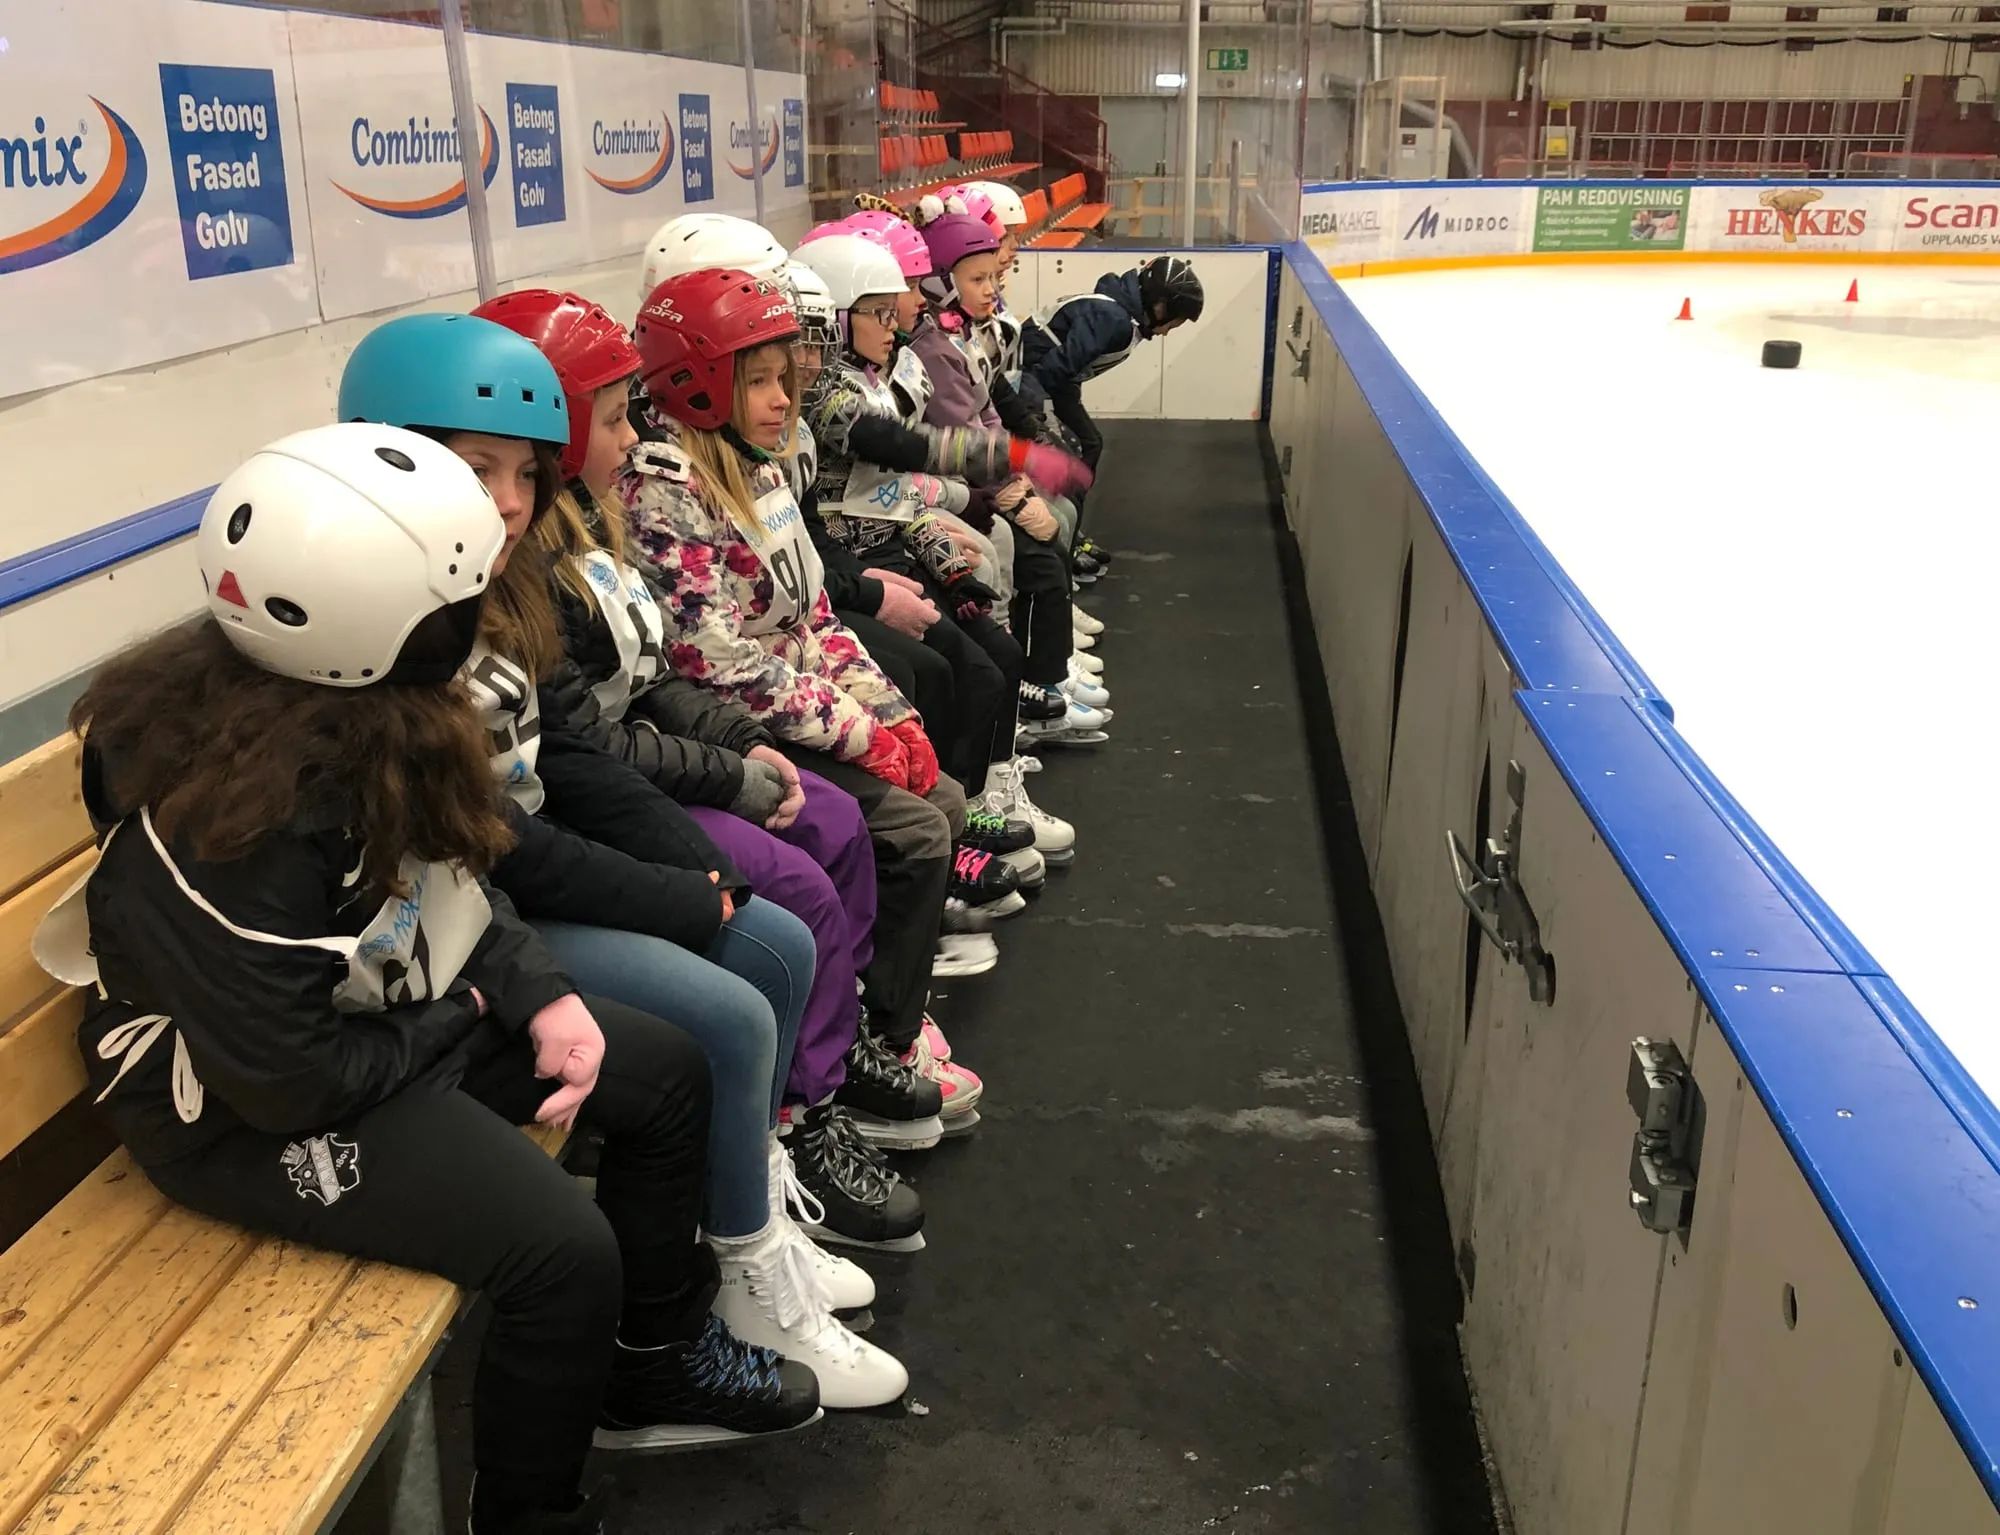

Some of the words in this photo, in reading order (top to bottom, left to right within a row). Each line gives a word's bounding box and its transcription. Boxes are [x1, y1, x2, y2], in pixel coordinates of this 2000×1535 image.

[179, 94, 268, 140] Betong
[514, 103, 555, 135] Betong
[683, 108, 708, 132] Betong
[352, 116, 461, 166] Combimi
[593, 119, 661, 155] Combimix
[685, 139, 705, 158] Fasad
[517, 143, 551, 168] Fasad
[187, 152, 260, 192] Fasad
[687, 168, 702, 188] Golv
[520, 182, 545, 207] Golv
[1543, 189, 1573, 206] PAM
[1578, 189, 1684, 206] REDOVISNING
[1444, 216, 1509, 233] MIDROC
[1725, 208, 1866, 236] HENKES
[1904, 197, 1998, 228] Scan
[196, 210, 248, 249] Golv
[1922, 234, 1988, 246] UPPLANDS
[646, 304, 684, 323] JOFA
